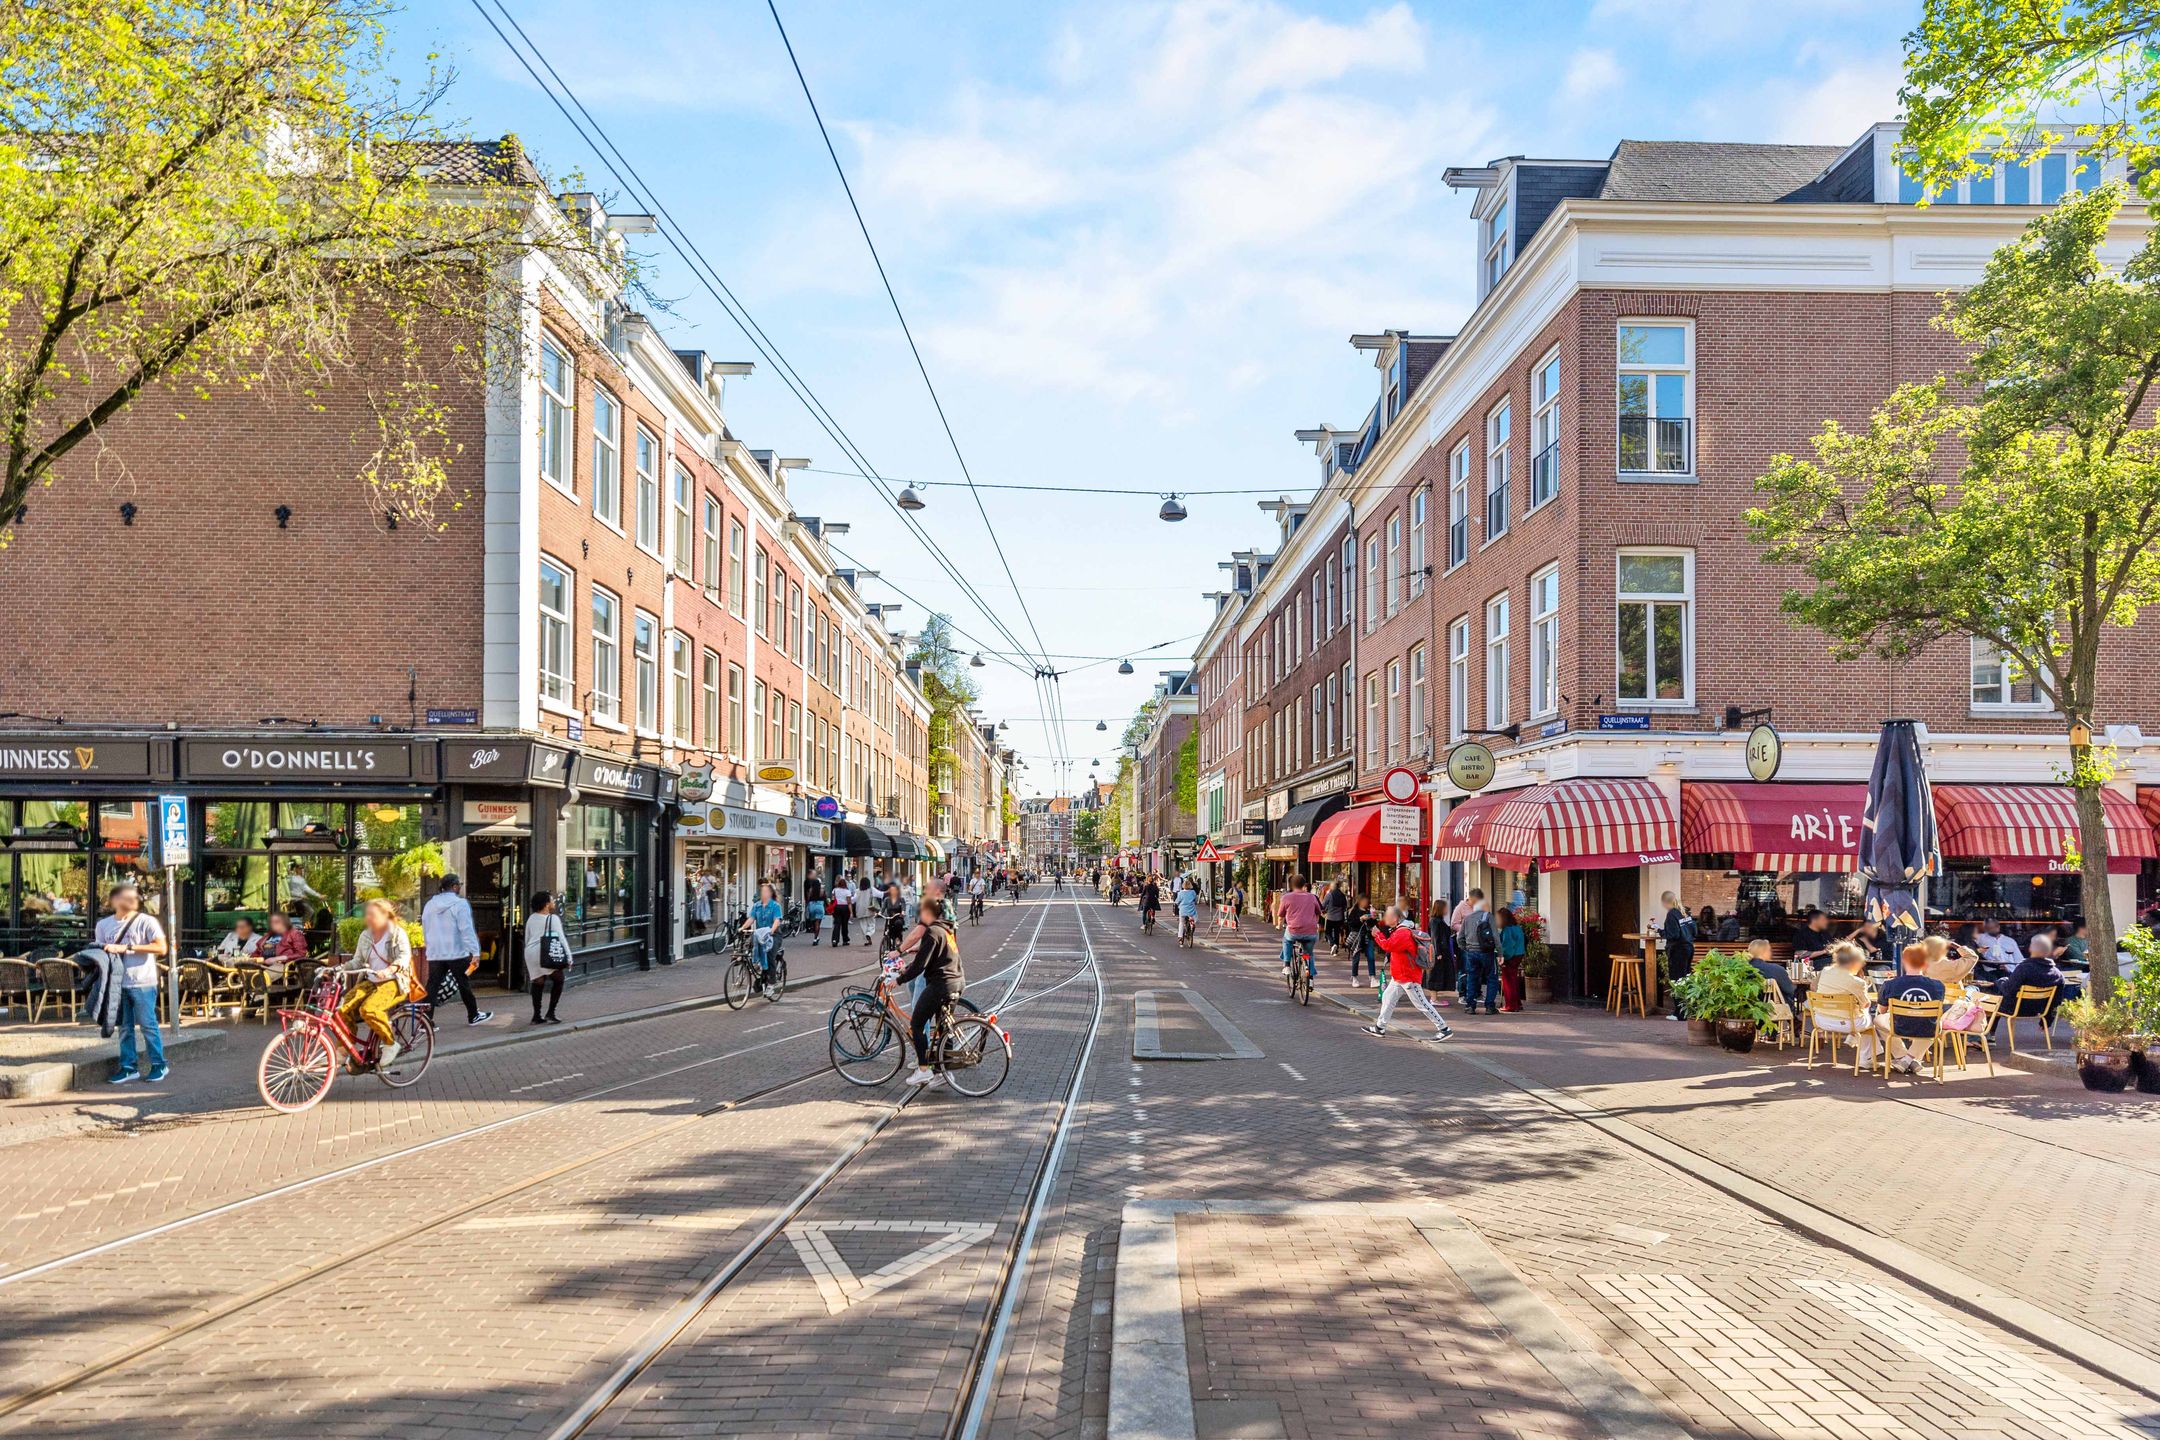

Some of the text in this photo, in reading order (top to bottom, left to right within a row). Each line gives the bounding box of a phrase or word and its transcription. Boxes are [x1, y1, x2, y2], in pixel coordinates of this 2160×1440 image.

[1603, 716, 1644, 724] QUELLIJNSTRAAT
[222, 749, 376, 769] O'DONNELL'S
[469, 748, 501, 769] Bar
[1464, 754, 1481, 762] CAFÉ
[593, 766, 643, 790] O'DONNELL'S
[477, 803, 518, 814] GUINNESS
[1639, 853, 1675, 864] Duvel
